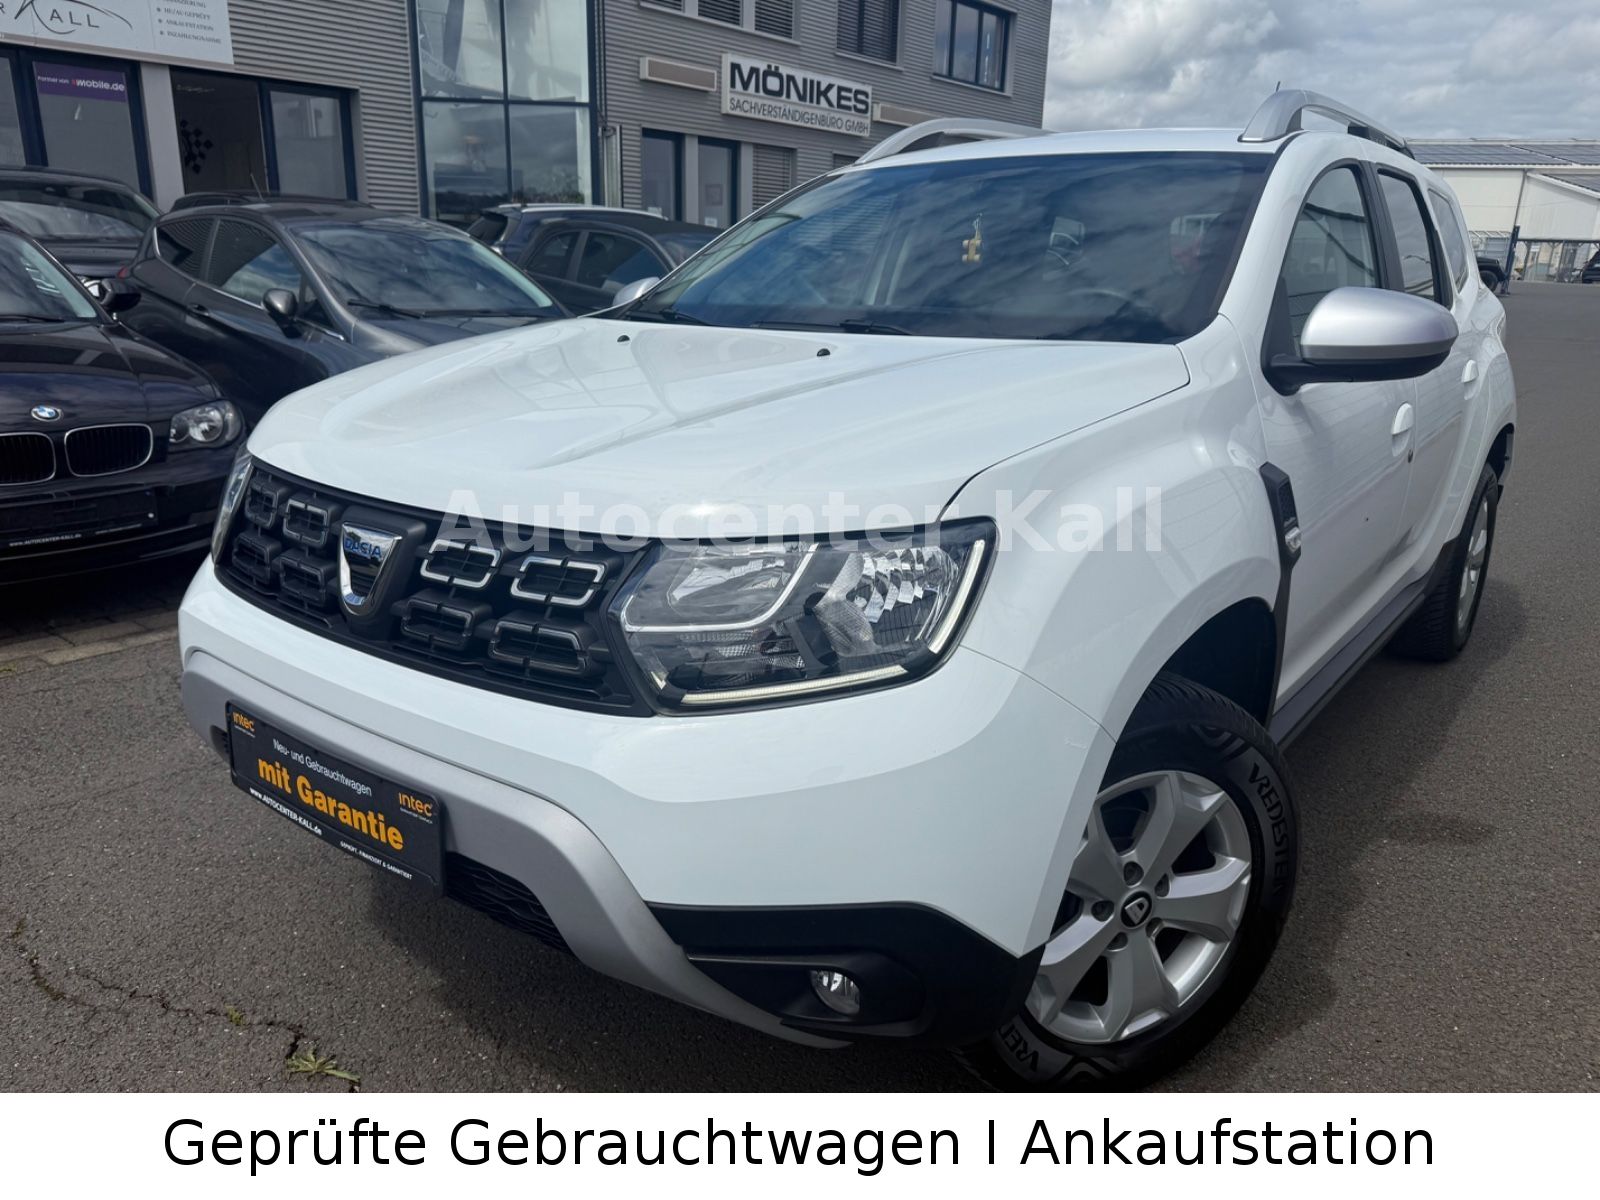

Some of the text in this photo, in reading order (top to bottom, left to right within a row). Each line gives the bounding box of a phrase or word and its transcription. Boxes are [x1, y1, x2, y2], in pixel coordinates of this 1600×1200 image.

[75, 79, 125, 92] mobile.de
[730, 62, 870, 115] MÖNIKES
[290, 750, 305, 765] und
[305, 755, 373, 797] Gebrauchtwagen
[258, 757, 405, 851] mit Garantie
